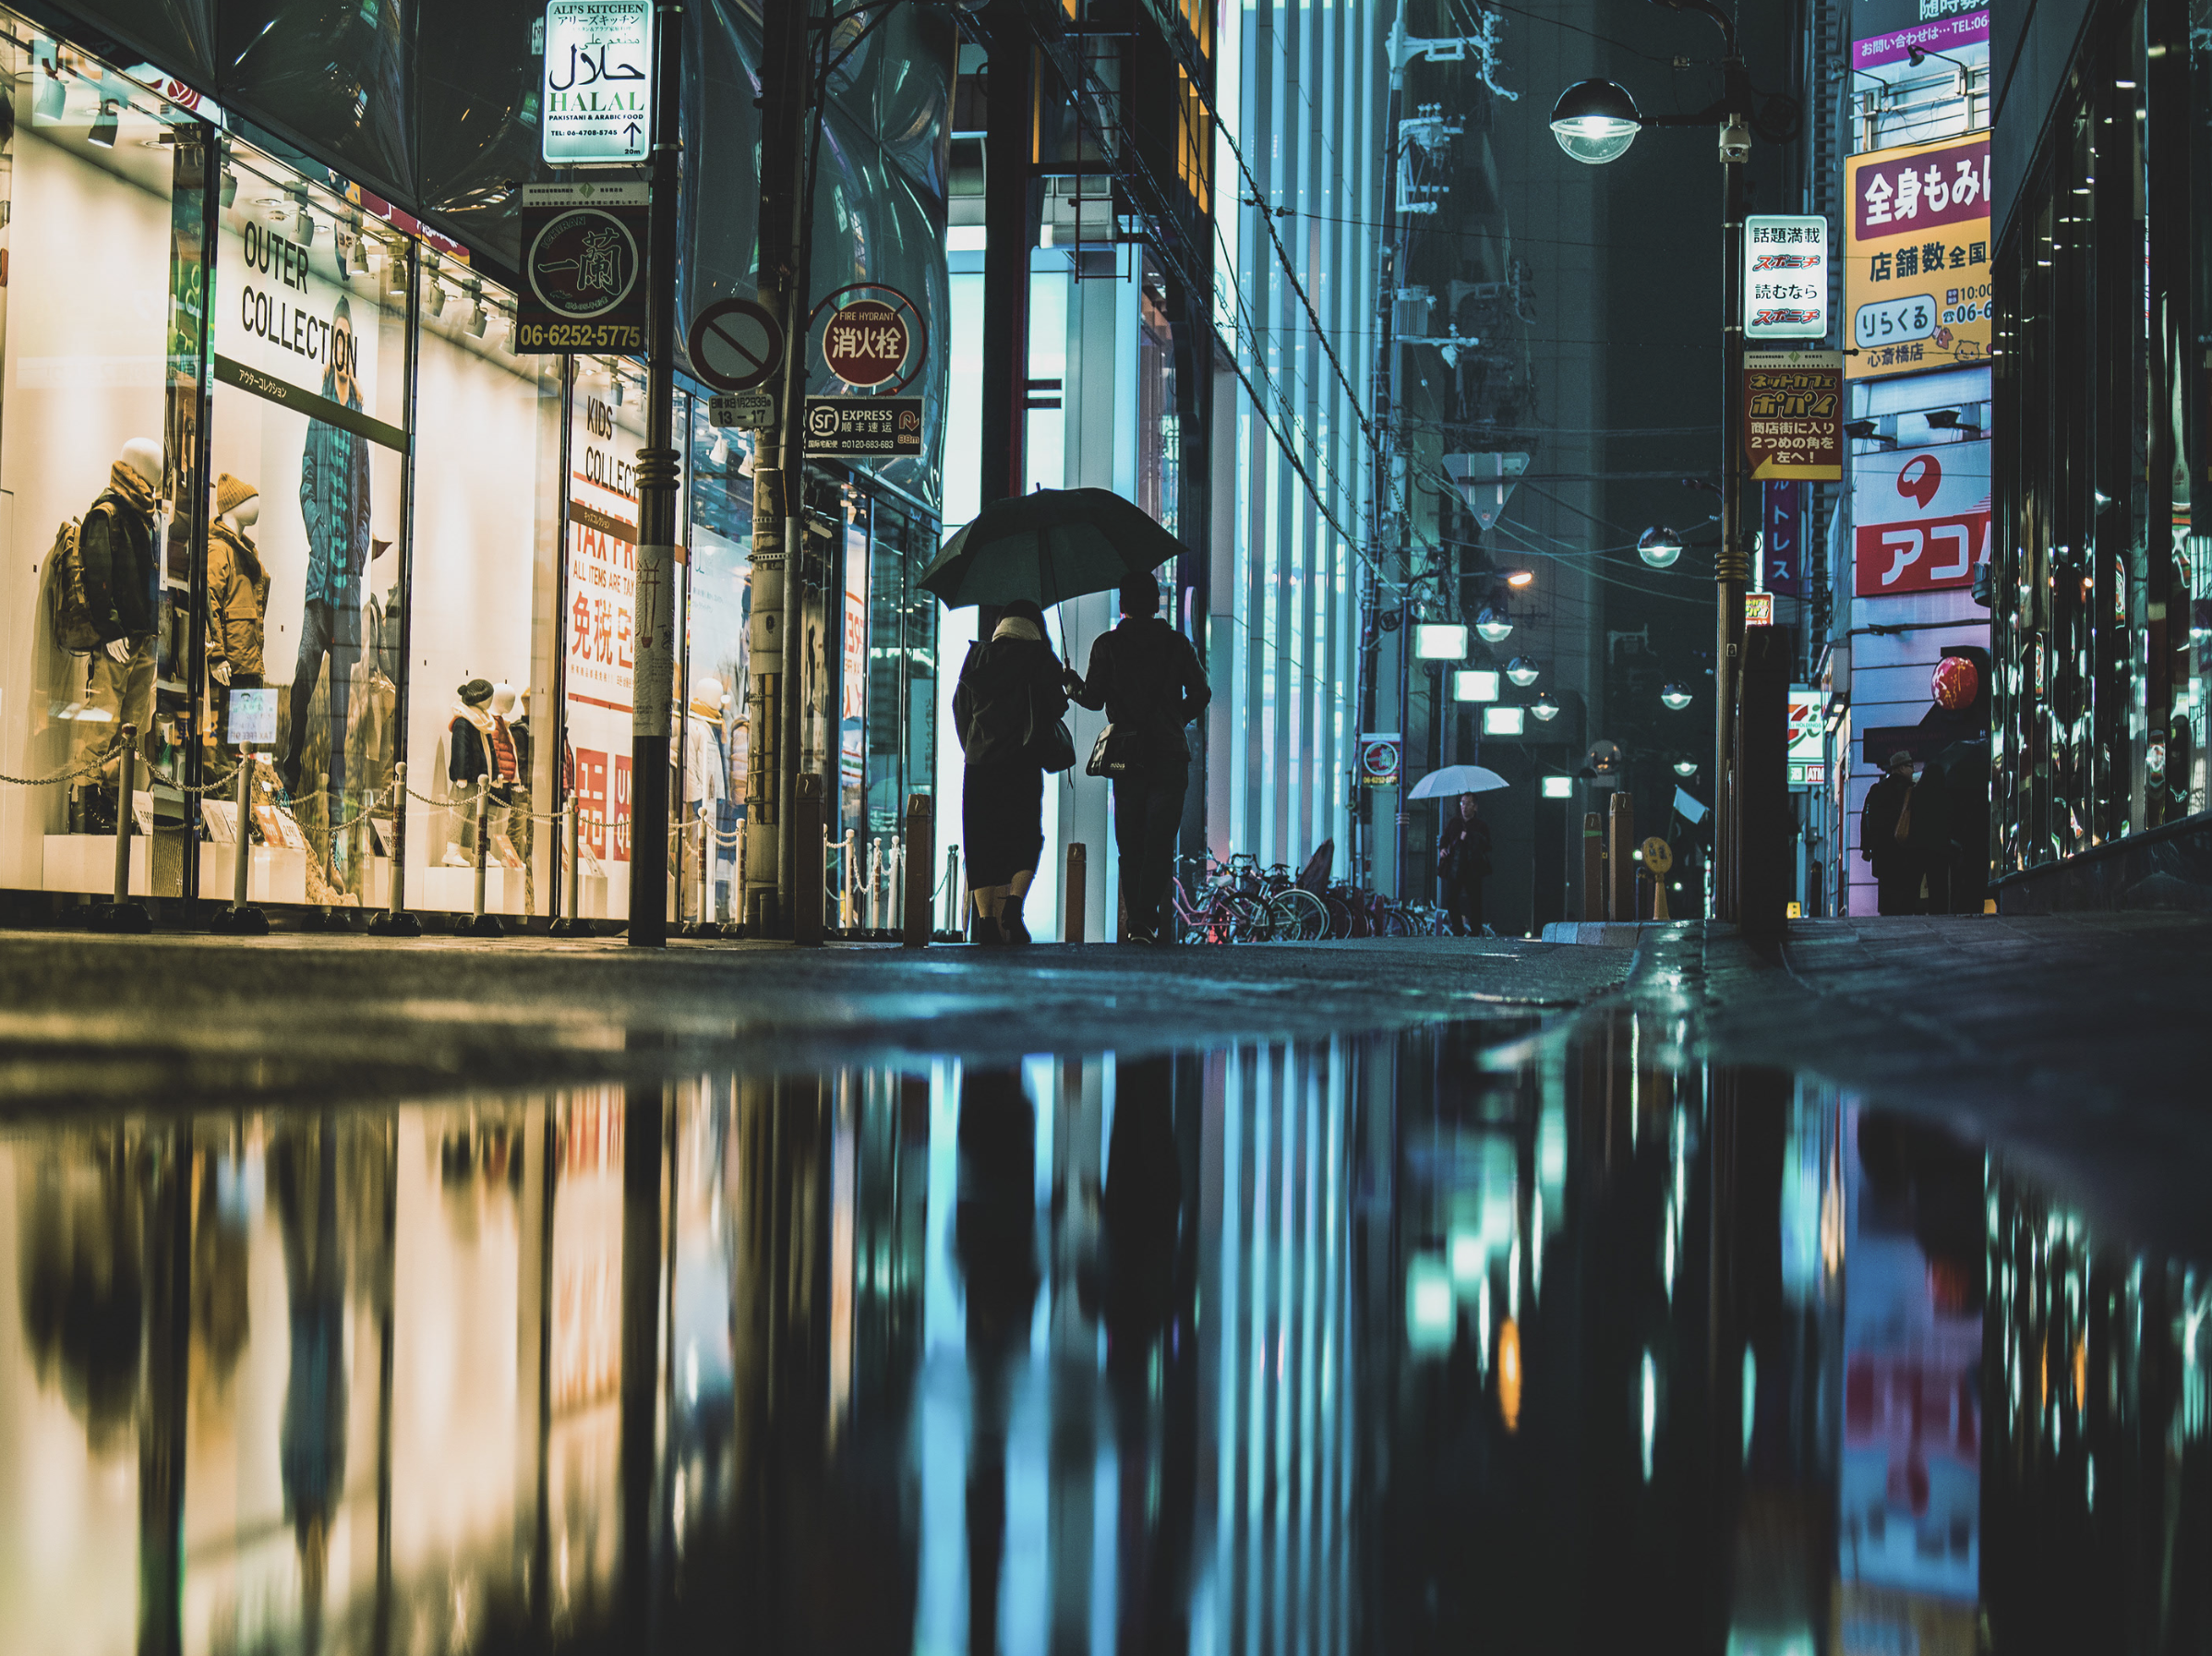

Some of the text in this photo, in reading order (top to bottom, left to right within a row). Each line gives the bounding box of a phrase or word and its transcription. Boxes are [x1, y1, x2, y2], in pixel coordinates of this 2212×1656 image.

[586, 4, 644, 14] KITCHEN
[558, 15, 640, 26] アリーズキッチン
[548, 43, 645, 91] حلال
[548, 91, 645, 112] HALAL
[540, 216, 586, 249] ICHIRAN
[1753, 227, 1821, 243] 話題満載
[244, 221, 308, 294] OUTER
[537, 227, 622, 296] 一蘭
[1752, 255, 1821, 271] スポニチ
[1755, 283, 1818, 299] 読むなら
[839, 312, 894, 321] FIRE HYDRANT
[1752, 308, 1820, 326] スポニチ
[1863, 306, 1928, 338] りらくる
[242, 285, 358, 378] COLLECTION
[520, 324, 641, 347] 06-6252-5775
[832, 326, 902, 359] 消火栓
[1867, 342, 1924, 368] 心斎橋店
[238, 369, 287, 399] アウターコレクション
[1750, 374, 1835, 390] ネットカフェ
[1750, 391, 1837, 418] ポパイ
[587, 395, 613, 441] KIDS
[842, 410, 893, 421] EXPRESS
[897, 434, 920, 444] 88m
[1751, 422, 1834, 435] 商店街に入り
[847, 439, 894, 449] 0120-683-683
[1751, 437, 1833, 449] 2つめの角を
[573, 559, 586, 582] ALL
[588, 564, 607, 588] ITEMS
[608, 571, 621, 594] ARE
[572, 591, 613, 666] 免税
[1808, 767, 1824, 781] ATM
